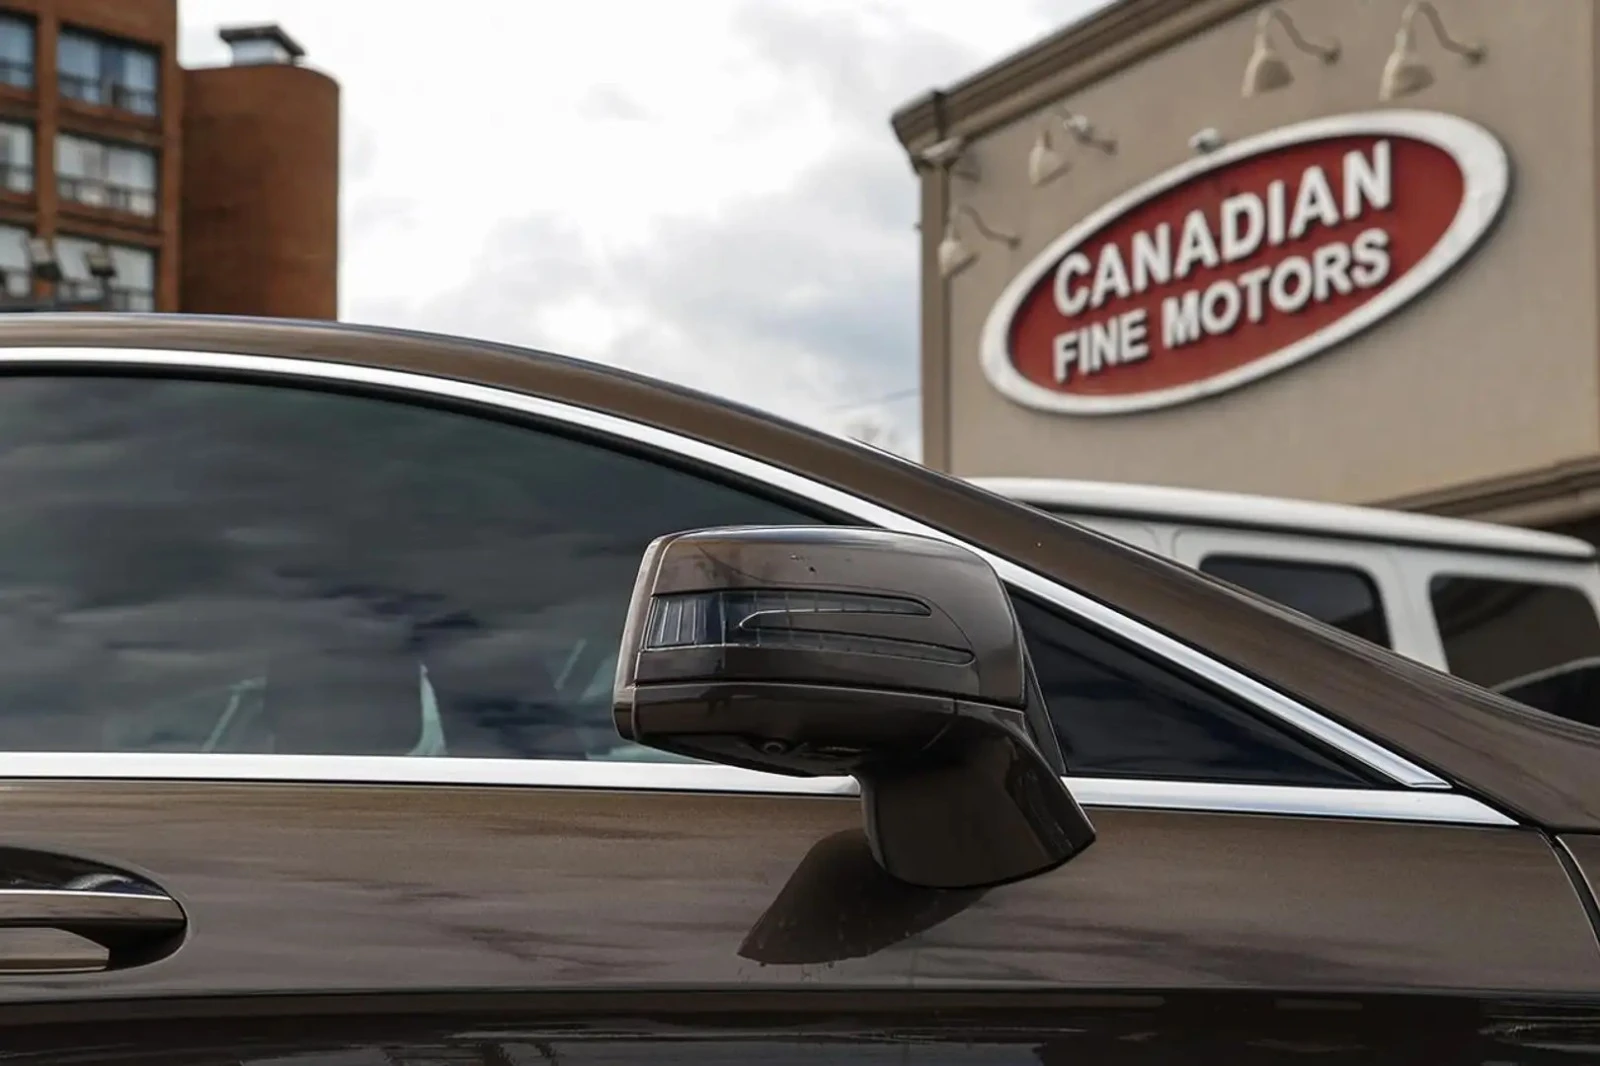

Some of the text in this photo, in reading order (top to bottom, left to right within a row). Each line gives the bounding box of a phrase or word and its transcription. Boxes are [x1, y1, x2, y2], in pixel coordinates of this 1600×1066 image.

[1053, 140, 1391, 317] CANADIAN
[1053, 228, 1390, 383] FINE MOTORS
